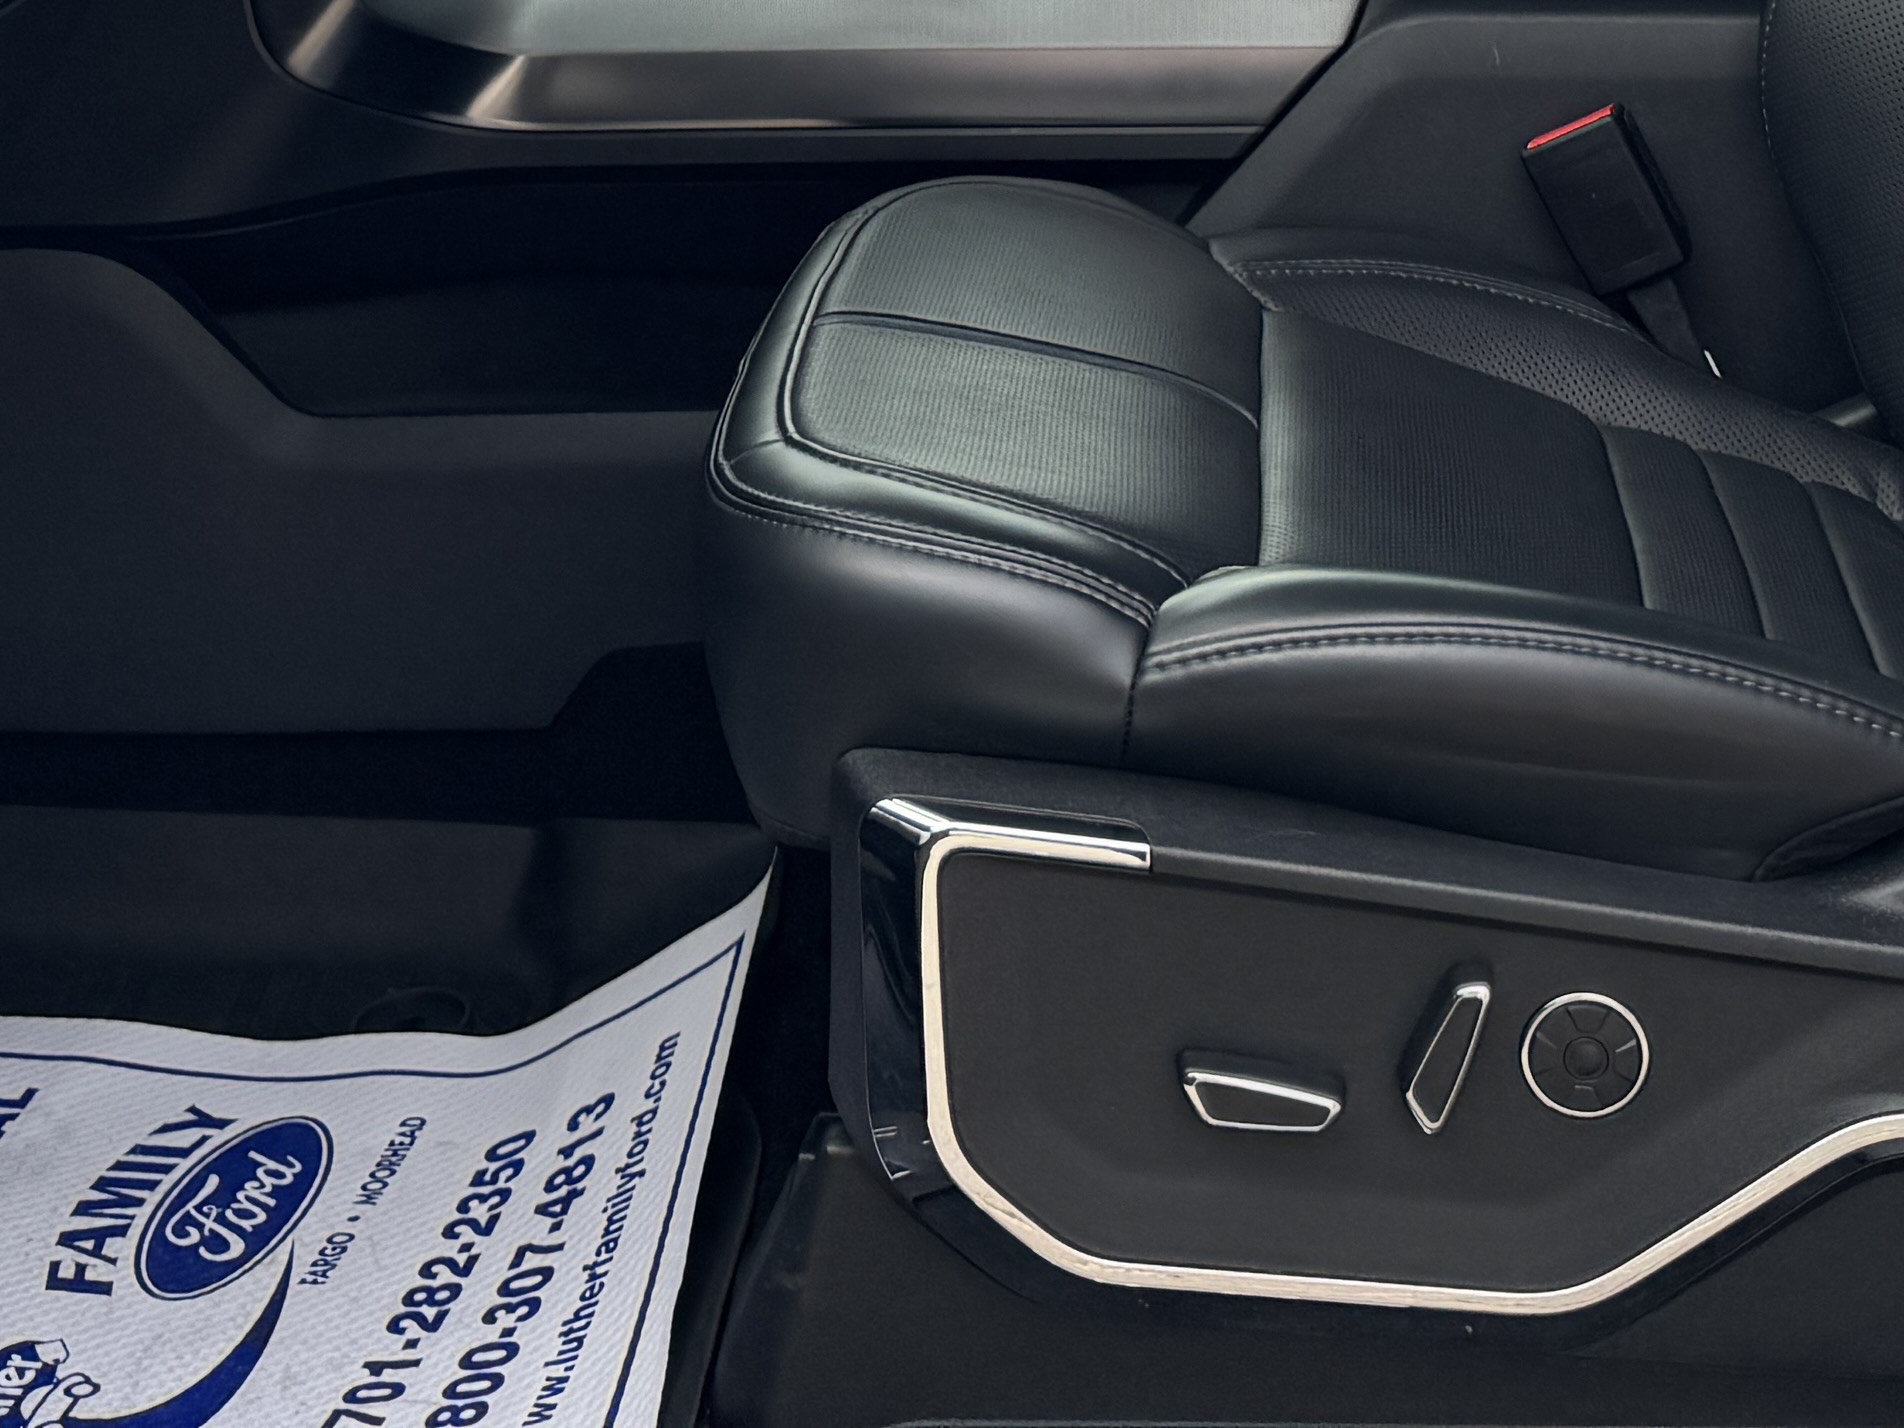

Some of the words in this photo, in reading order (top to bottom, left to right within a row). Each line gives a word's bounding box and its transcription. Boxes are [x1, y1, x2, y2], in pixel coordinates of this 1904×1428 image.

[44, 1104, 241, 1297] FAMILY
[165, 1150, 304, 1263] Ford
[297, 1231, 356, 1286] FARGO
[355, 1116, 428, 1206] MOORHEAD
[321, 1128, 538, 1428] 701-282-2350
[424, 1091, 616, 1428] 800-307-4813
